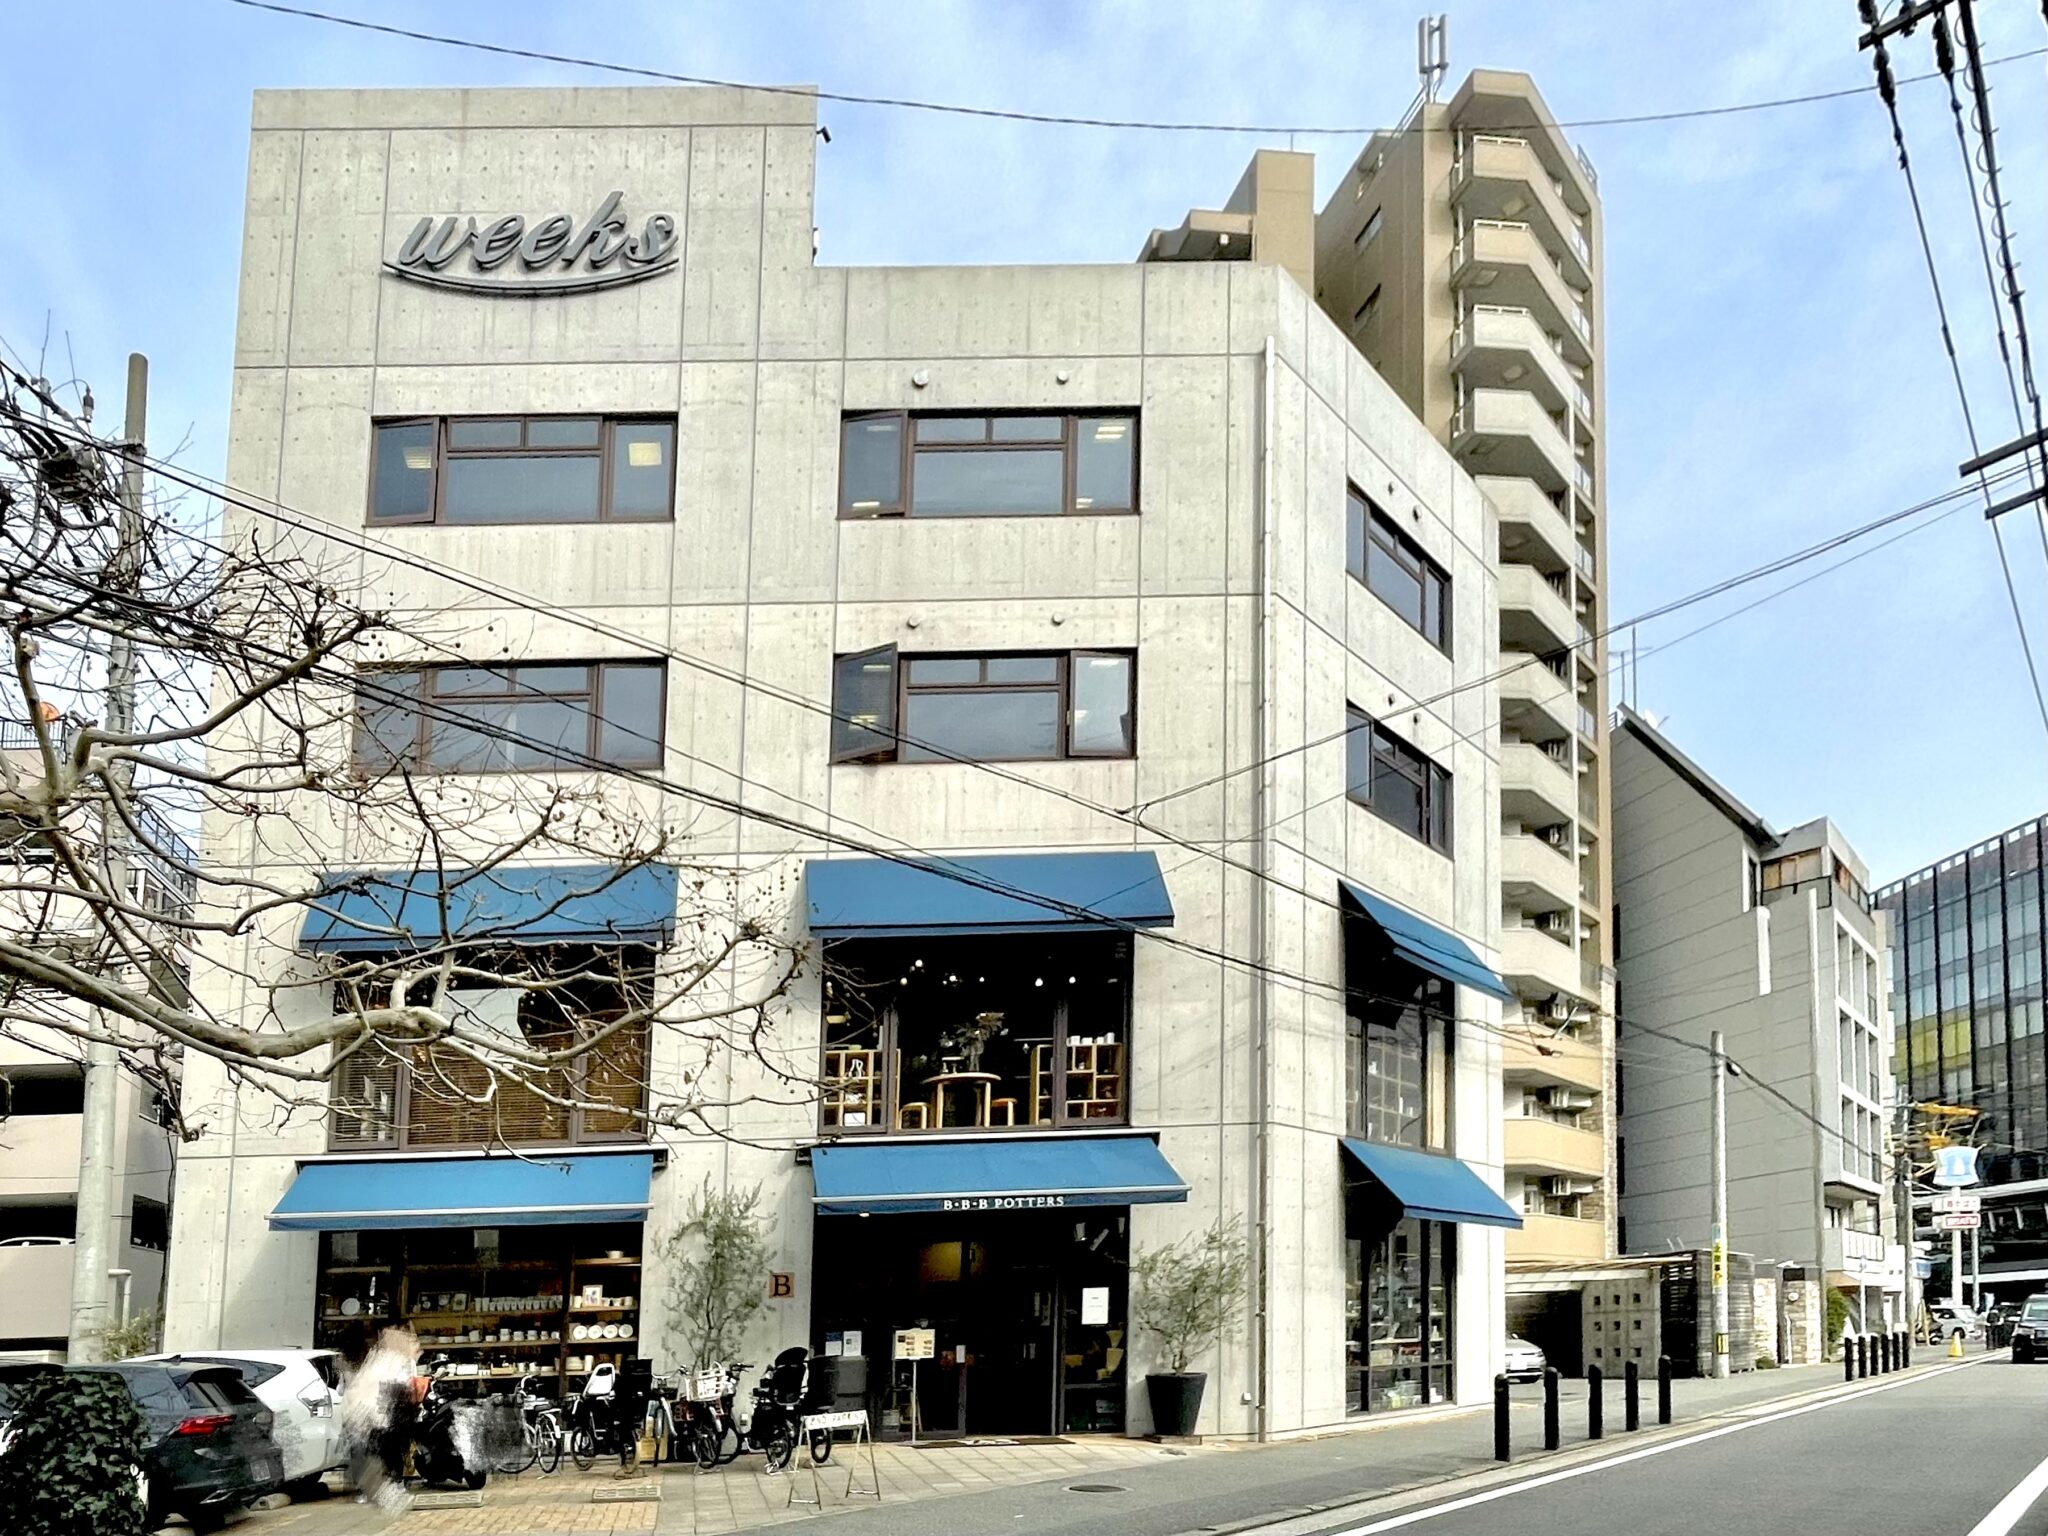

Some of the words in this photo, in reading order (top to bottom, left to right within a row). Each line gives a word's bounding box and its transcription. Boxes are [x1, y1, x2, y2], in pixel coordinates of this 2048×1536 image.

[398, 190, 680, 269] weeks
[994, 1196, 1065, 1209] POTTERS
[771, 1274, 791, 1297] B
